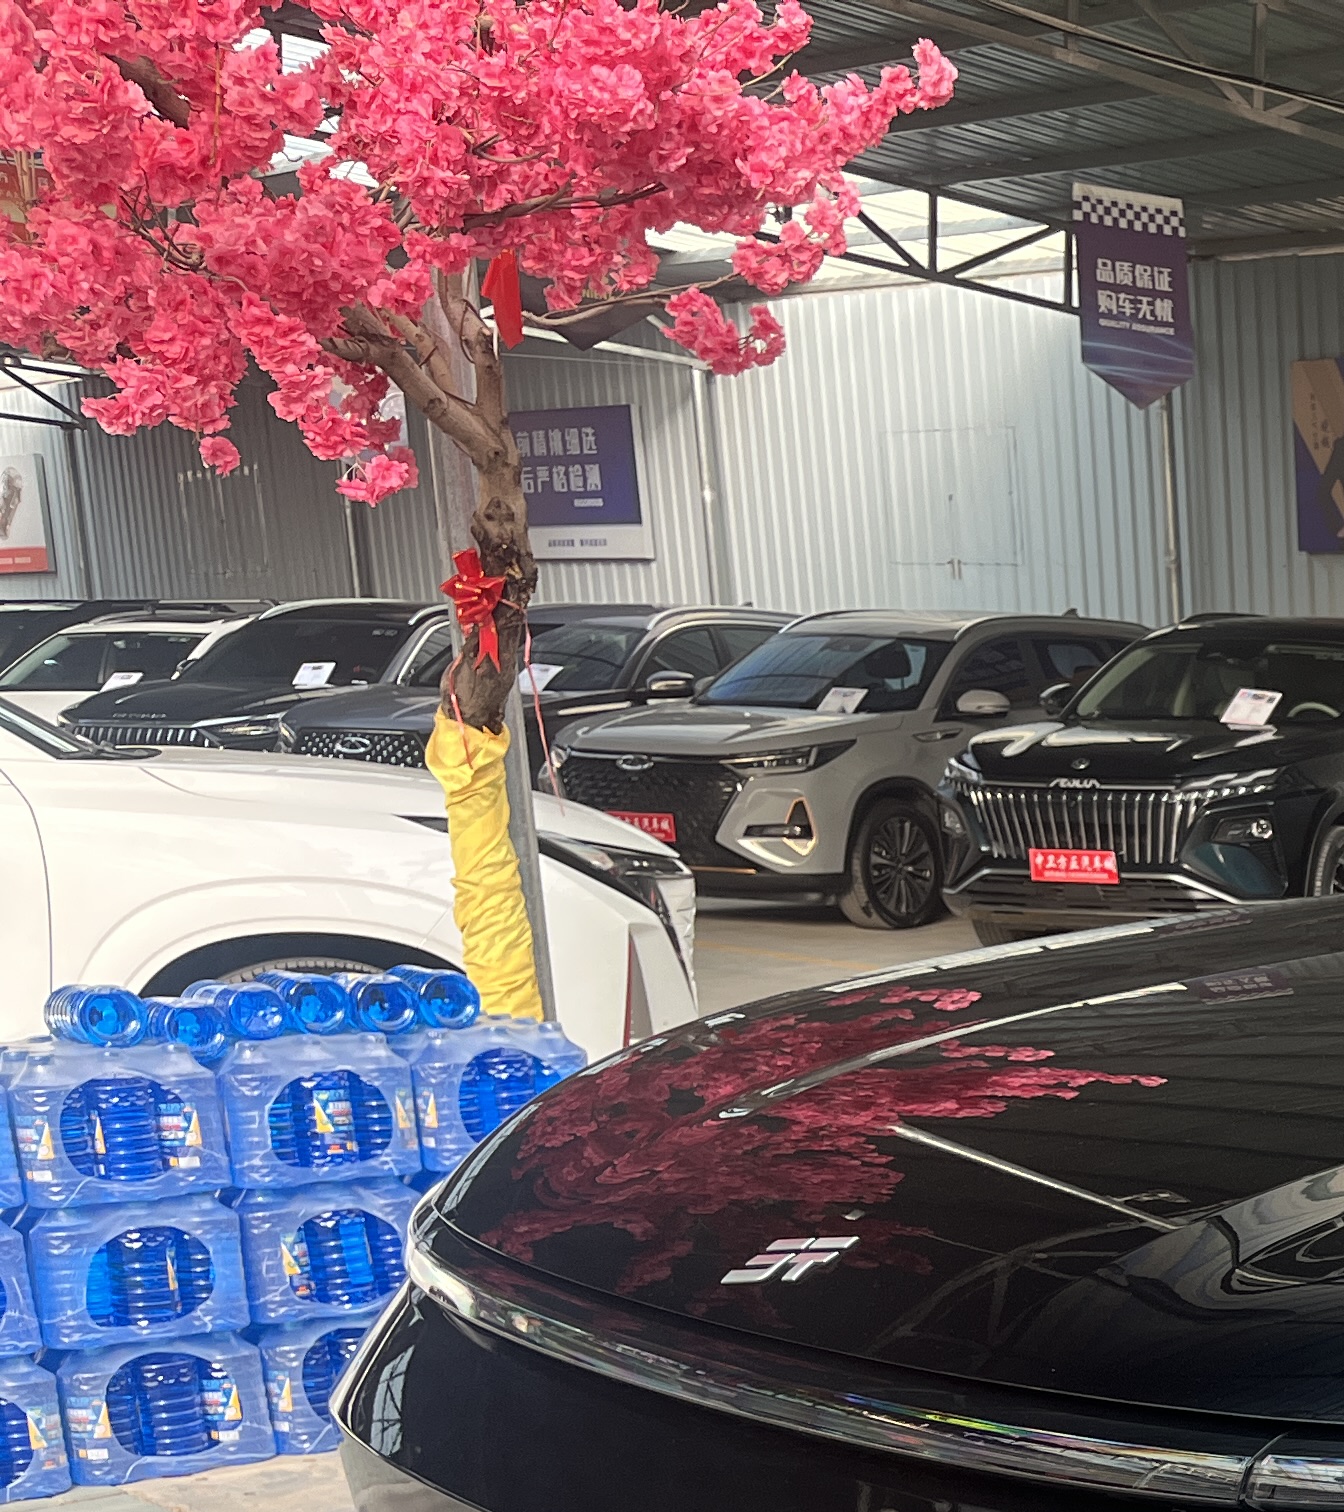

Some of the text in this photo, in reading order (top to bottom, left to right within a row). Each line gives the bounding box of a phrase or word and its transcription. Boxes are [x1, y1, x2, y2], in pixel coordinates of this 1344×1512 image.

[1096, 258, 1173, 291] 品质保证
[1097, 290, 1174, 322] 购车无忧
